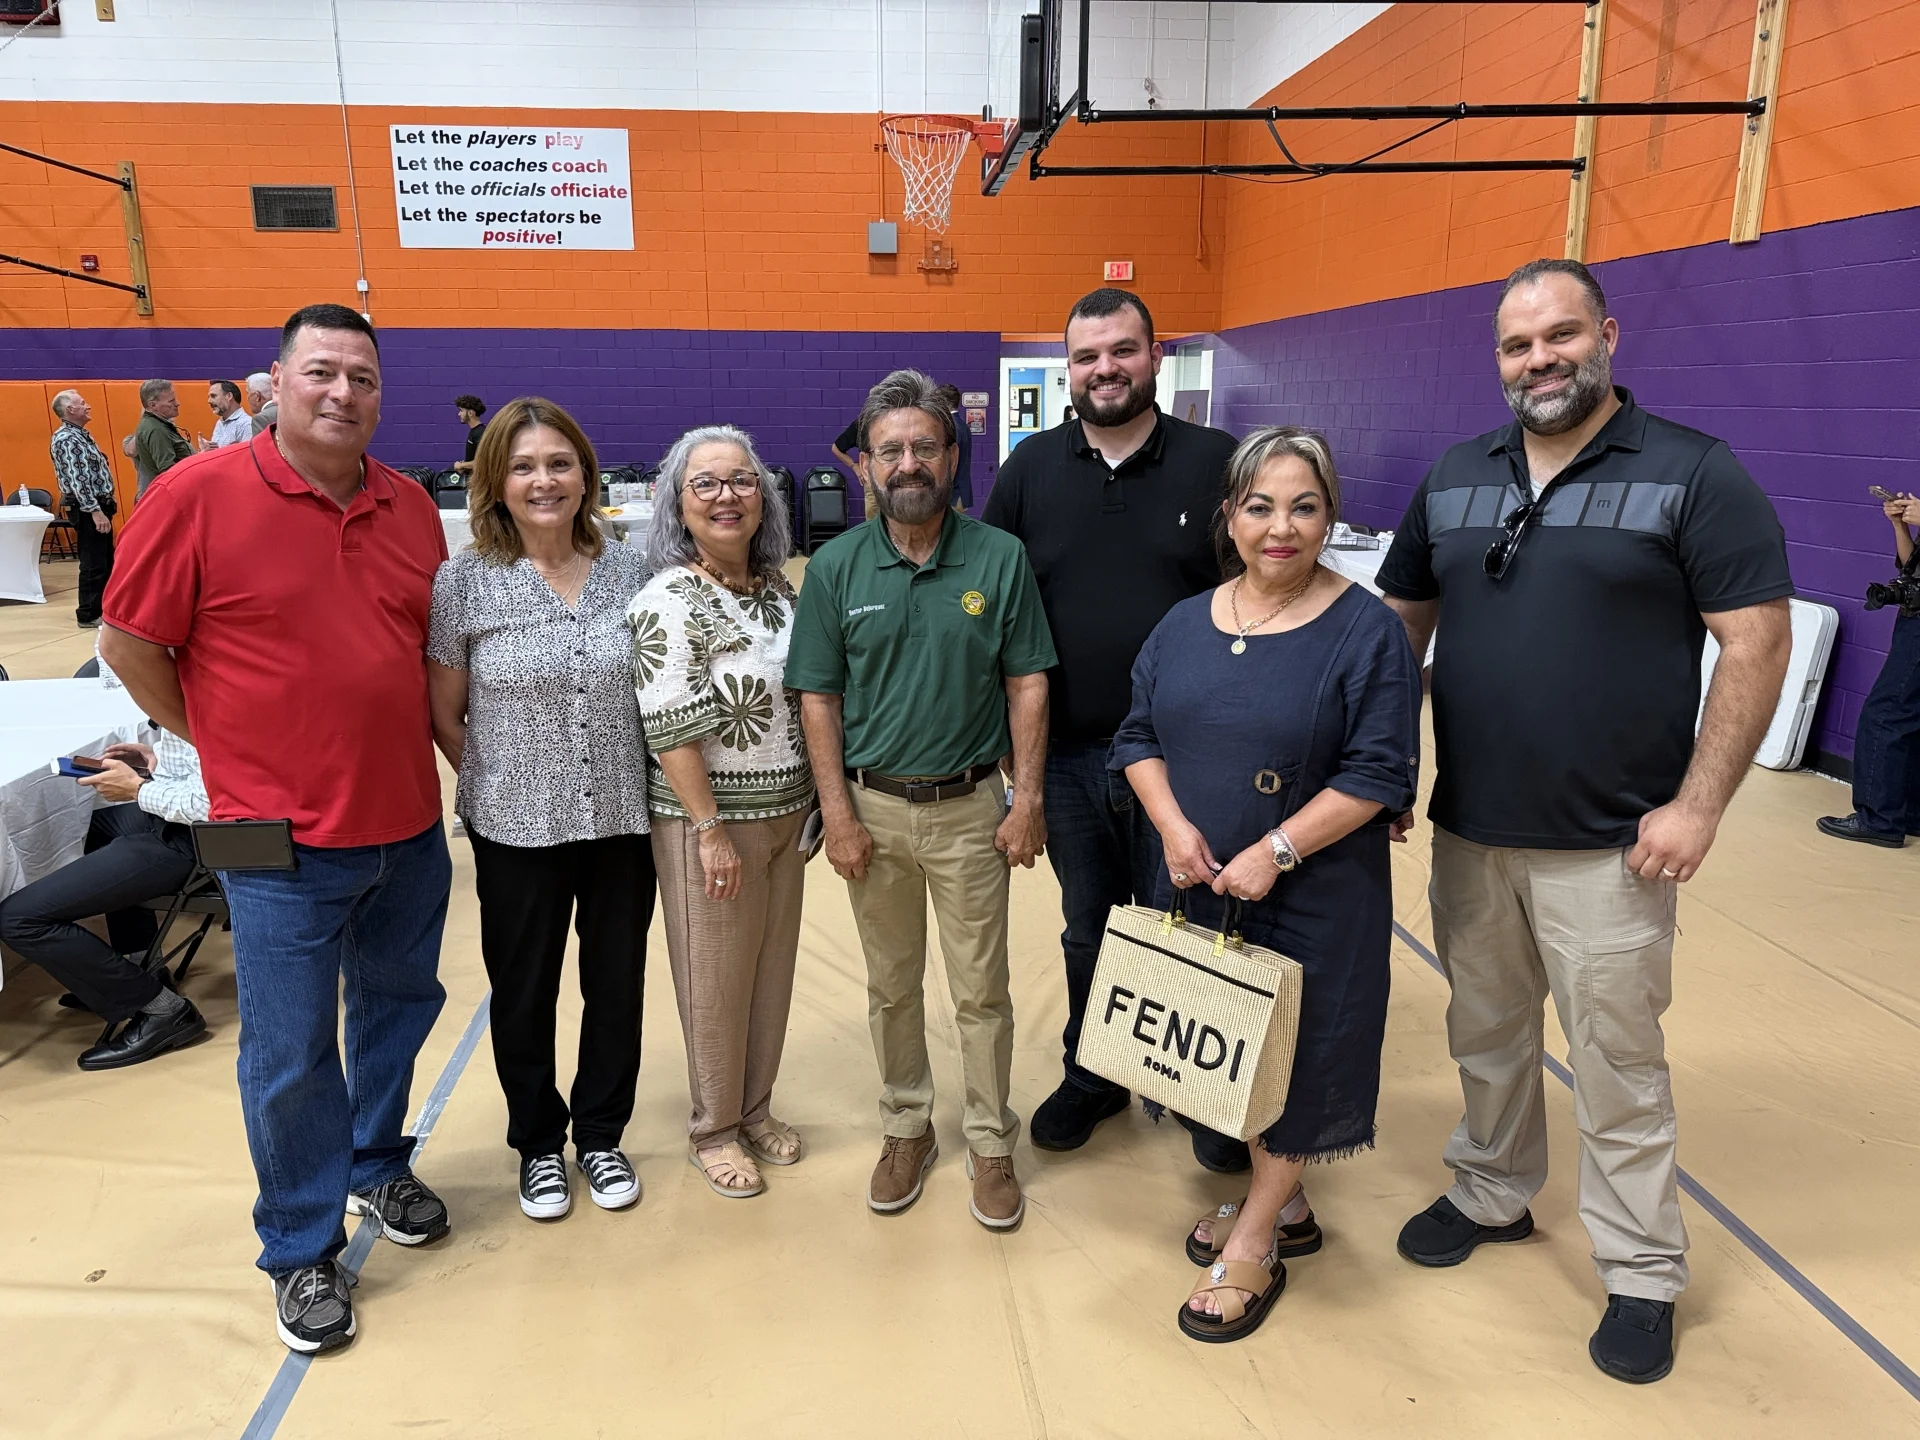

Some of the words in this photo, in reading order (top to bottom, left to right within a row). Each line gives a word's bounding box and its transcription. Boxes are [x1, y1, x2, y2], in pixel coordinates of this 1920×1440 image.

[395, 129, 425, 144] Let
[431, 130, 462, 145] the
[467, 131, 537, 148] players
[545, 132, 583, 150] play
[397, 156, 428, 171] Let
[433, 156, 464, 171] the
[469, 158, 548, 172] coaches
[552, 159, 608, 173] coach
[399, 180, 429, 195] Let
[435, 180, 465, 196] the
[470, 181, 546, 197] officials
[550, 182, 627, 199] officiate
[401, 206, 431, 222] Let
[437, 207, 467, 222] the
[475, 209, 575, 226] spectators
[580, 210, 602, 224] be
[482, 229, 563, 245] positive!
[1109, 263, 1129, 278] EXIT
[1104, 985, 1245, 1082] FENDI
[1143, 1056, 1181, 1083] ROMA
